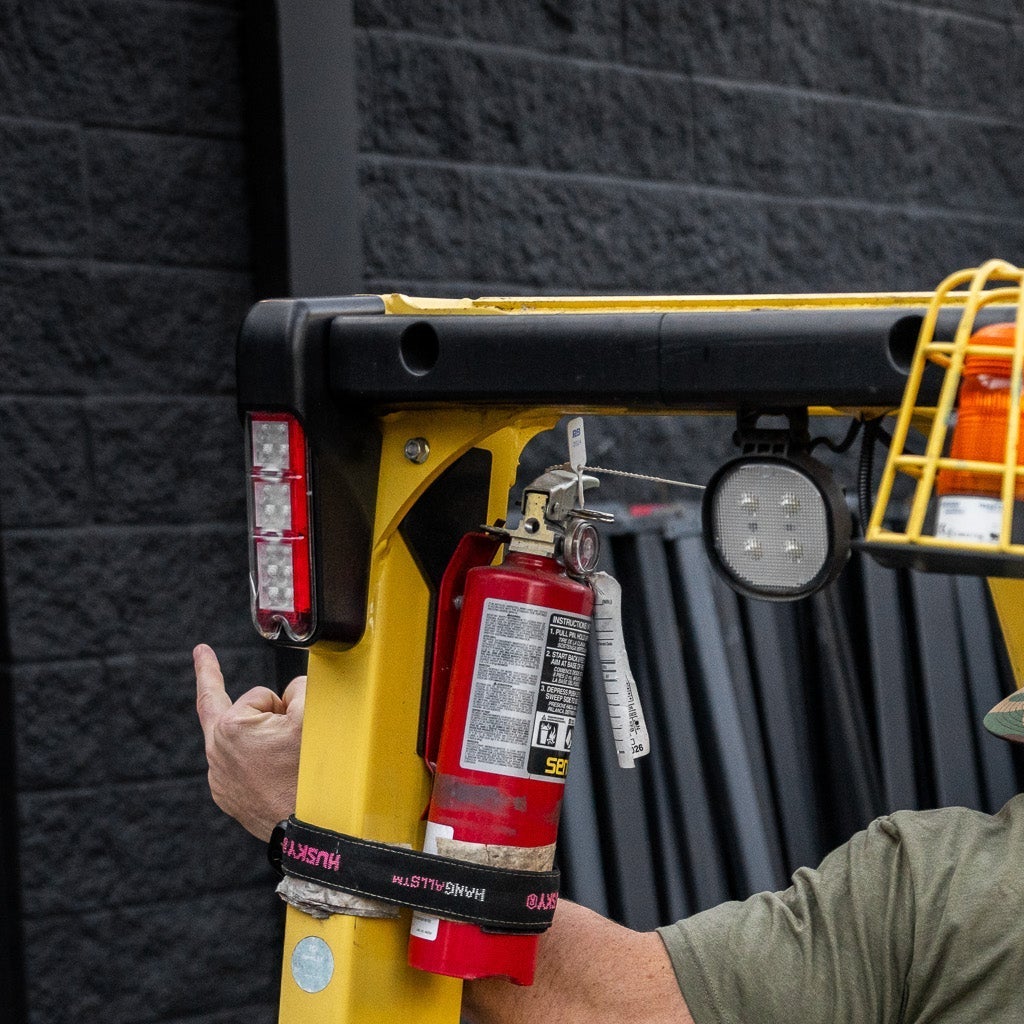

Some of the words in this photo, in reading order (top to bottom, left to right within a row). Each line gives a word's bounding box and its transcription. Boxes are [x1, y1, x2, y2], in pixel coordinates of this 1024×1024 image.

[555, 628, 569, 638] PULL
[552, 651, 567, 660] START
[550, 658, 561, 666] AIM
[546, 685, 569, 696] DEPRESS
[545, 692, 563, 702] SWEEP
